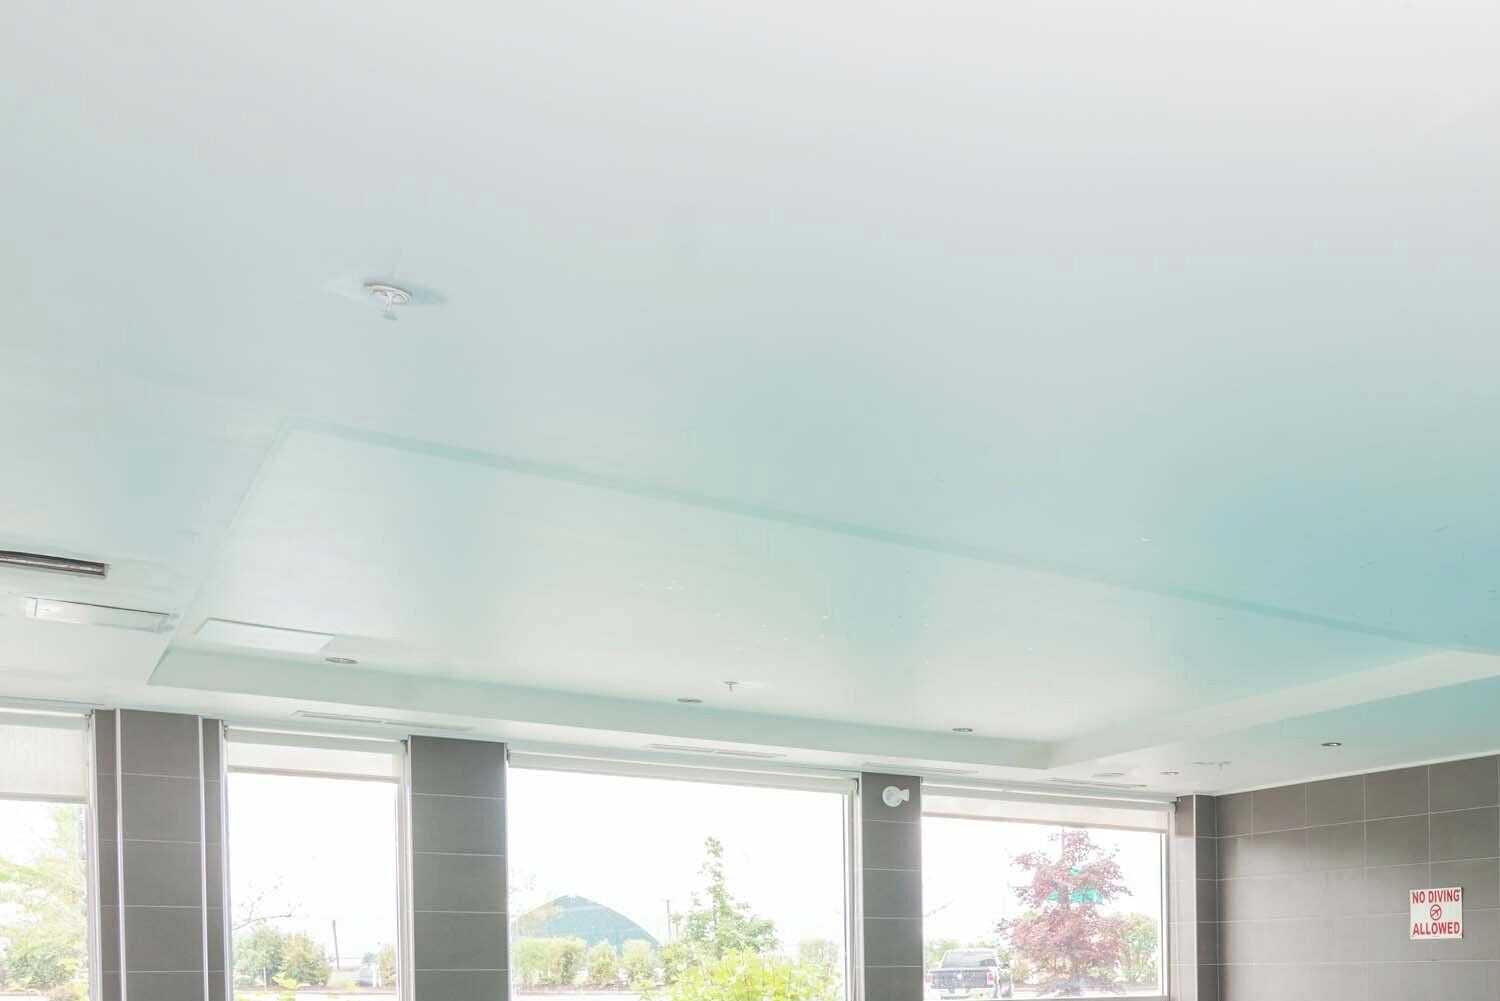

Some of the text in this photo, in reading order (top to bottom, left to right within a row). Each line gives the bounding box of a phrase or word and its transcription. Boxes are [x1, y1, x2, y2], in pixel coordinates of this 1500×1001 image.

[1412, 889, 1460, 904] NO DIVING
[1412, 921, 1460, 936] ALLOWED
